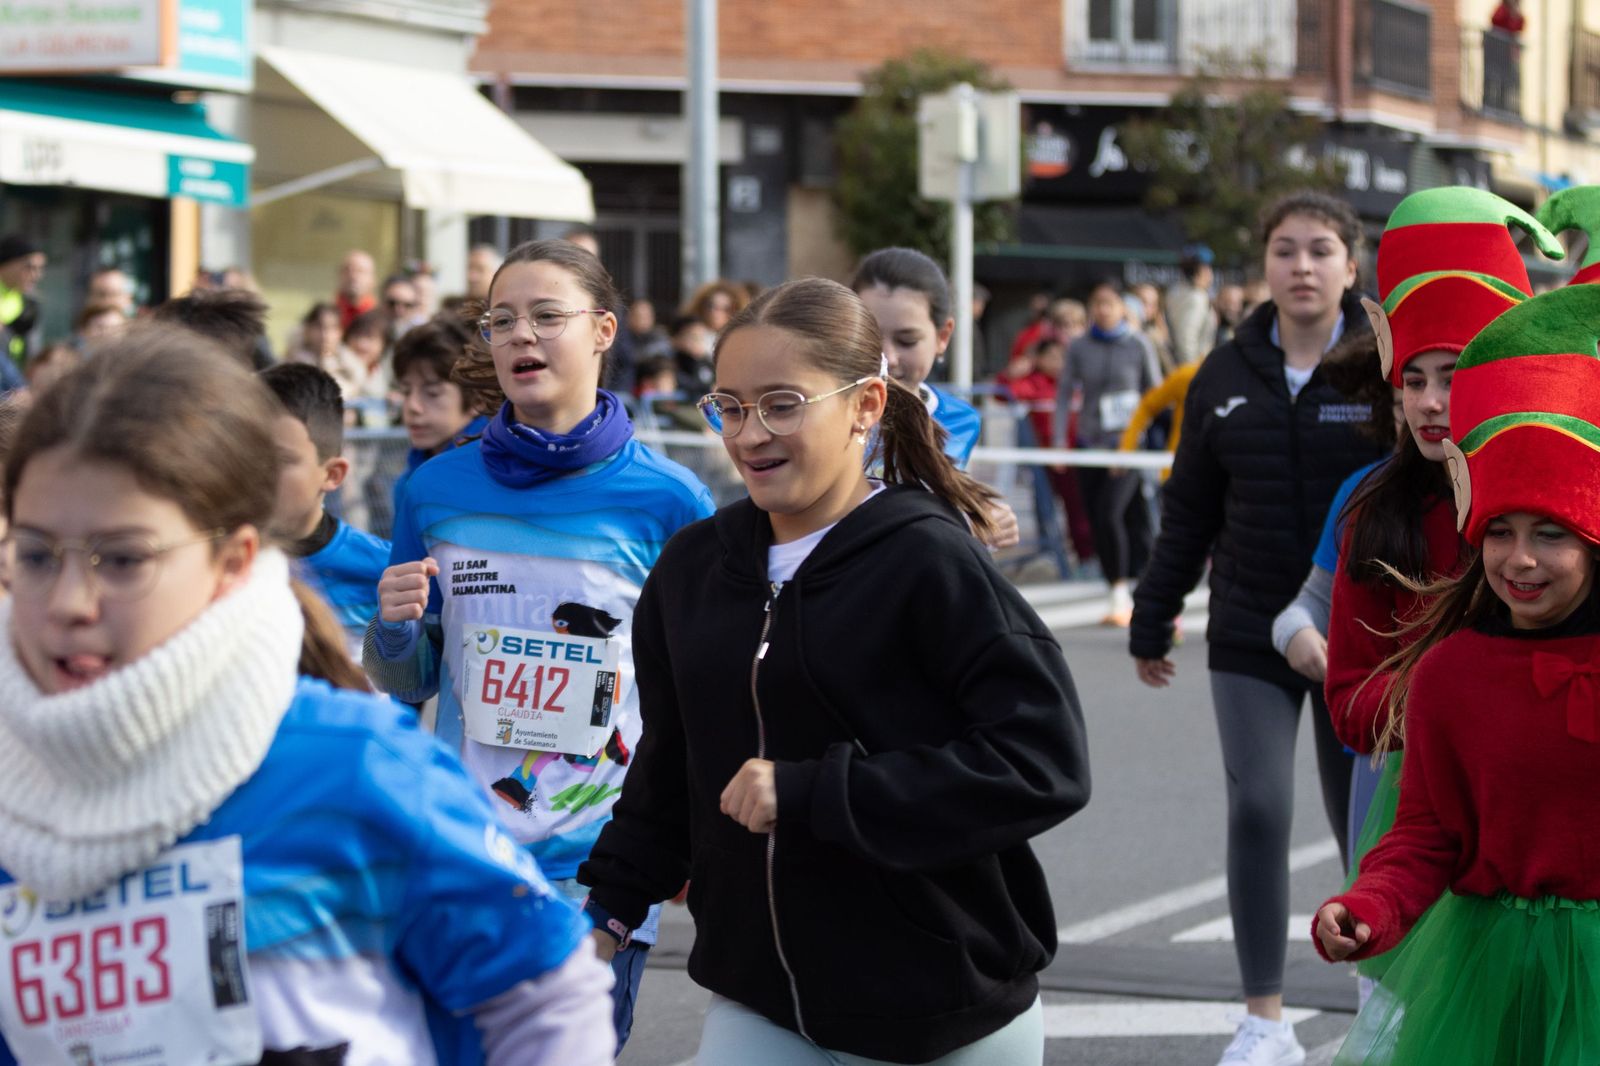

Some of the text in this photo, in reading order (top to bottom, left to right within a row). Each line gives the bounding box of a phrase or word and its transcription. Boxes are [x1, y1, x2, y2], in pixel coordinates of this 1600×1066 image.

[466, 559, 488, 570] SAN
[452, 571, 499, 584] SILVESTRE
[452, 584, 517, 596] SALMANTINA
[501, 635, 603, 664] SETEL
[481, 658, 570, 713] 6412
[497, 706, 543, 721] CLAUDIA
[515, 728, 559, 740] Ayuntamiento
[514, 737, 557, 748] de Salamanca
[11, 915, 171, 1027] 6363
